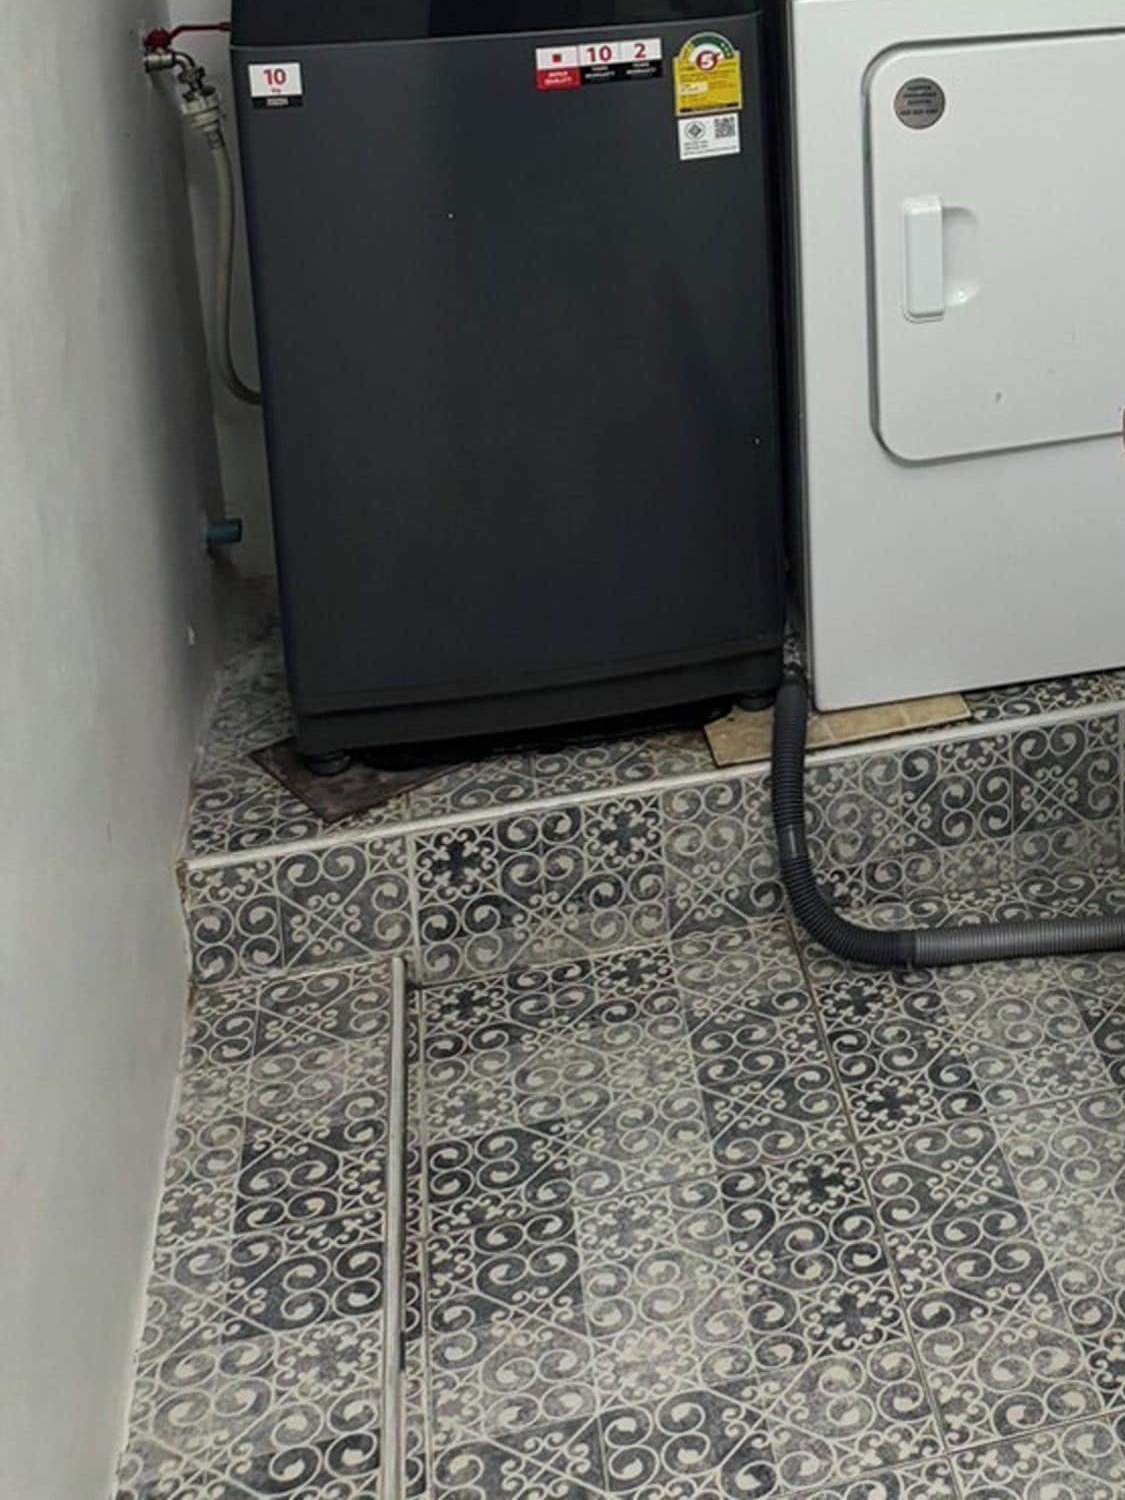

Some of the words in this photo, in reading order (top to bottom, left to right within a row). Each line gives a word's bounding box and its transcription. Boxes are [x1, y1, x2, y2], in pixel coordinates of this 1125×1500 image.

[587, 45, 613, 62] 10
[634, 42, 646, 59] 2
[263, 68, 287, 86] 10
